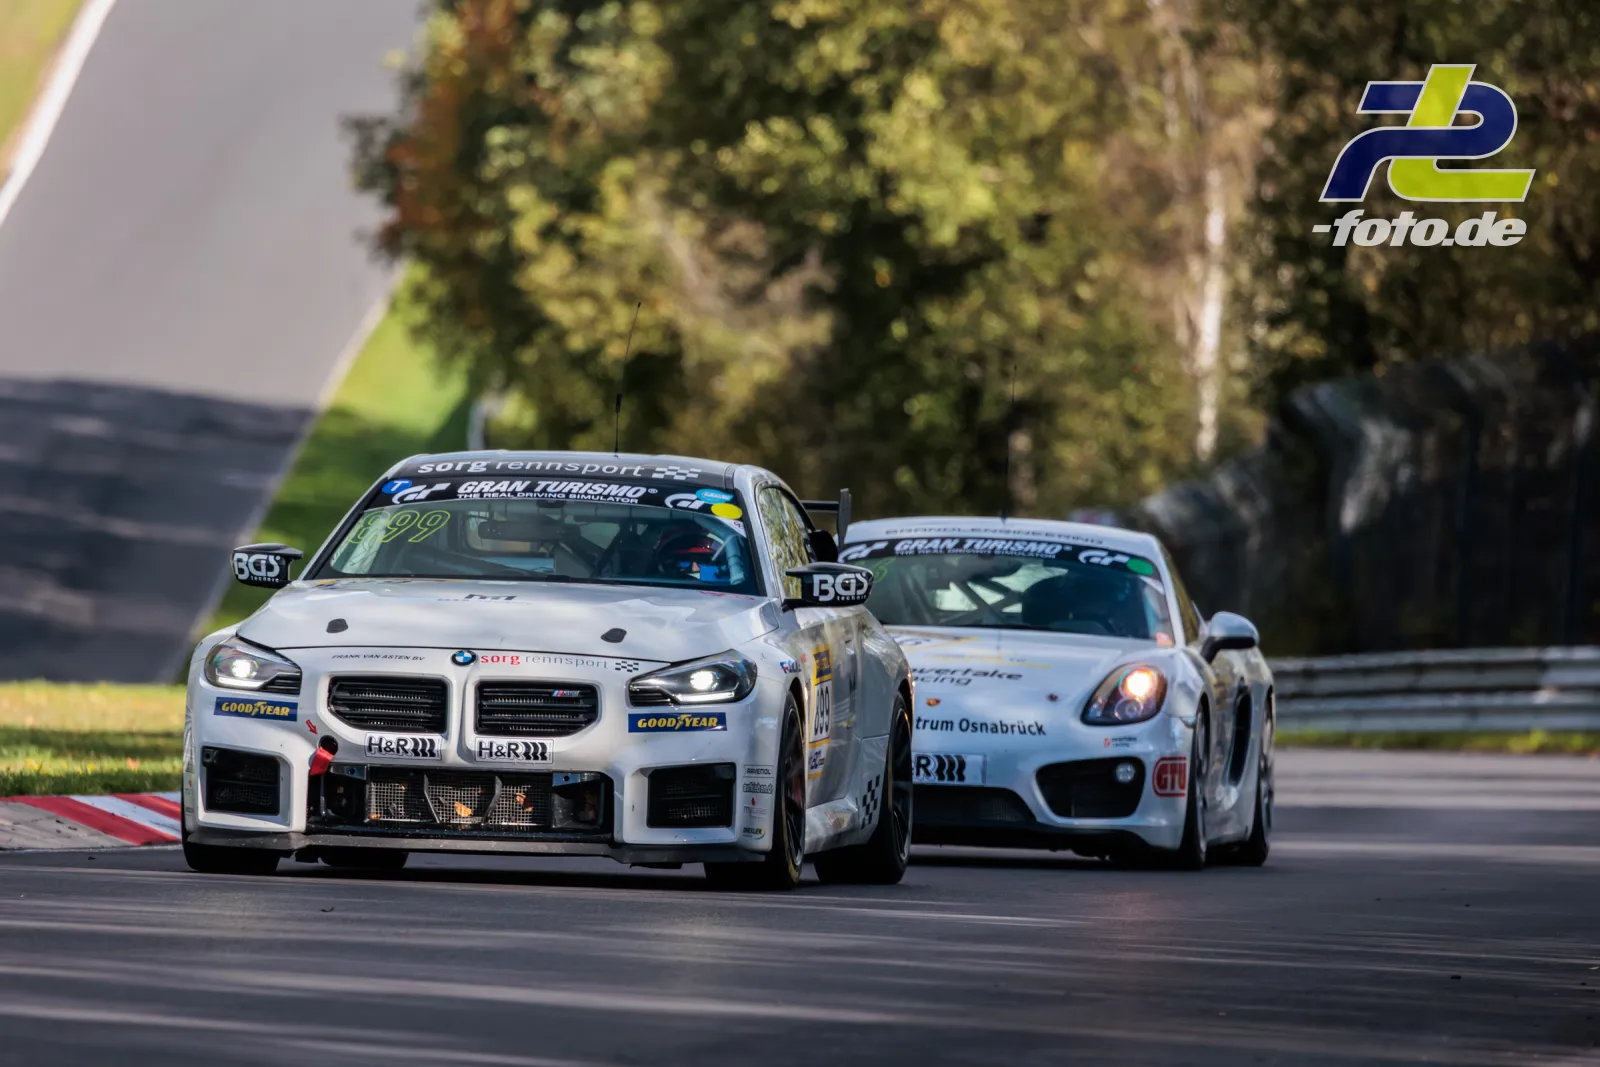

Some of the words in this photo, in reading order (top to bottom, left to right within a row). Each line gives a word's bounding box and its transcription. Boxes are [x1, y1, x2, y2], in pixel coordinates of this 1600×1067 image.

[417, 460, 493, 474] sorg
[495, 460, 645, 477] rennsport
[457, 480, 532, 494] GRAN
[569, 493, 639, 504] SIMULATOR
[349, 509, 451, 544] 899
[893, 538, 961, 552] GRAN
[233, 553, 281, 580] BGS
[812, 572, 869, 602] BGS
[480, 654, 521, 666] sorg
[525, 654, 609, 669] rennsport
[221, 701, 291, 716] GOODYEAR
[637, 713, 719, 730] GOODYEAR
[915, 716, 954, 732] trum
[958, 717, 1047, 736] Osnabrück
[367, 736, 411, 755] H&R
[478, 740, 522, 759] H&R
[746, 767, 772, 775] RAVENOL
